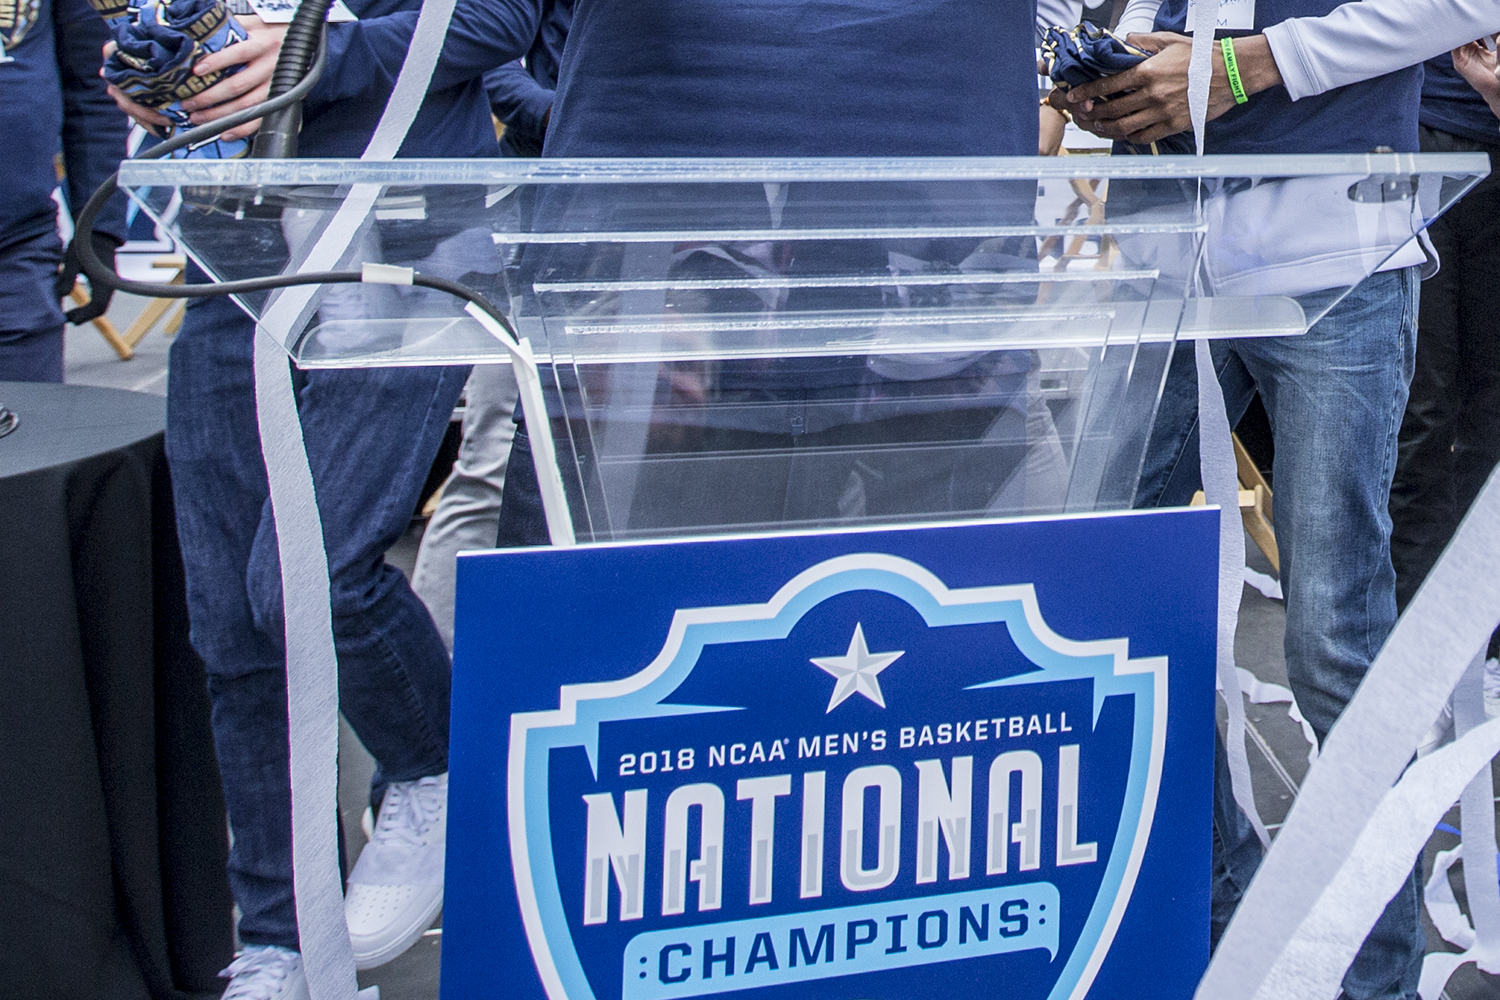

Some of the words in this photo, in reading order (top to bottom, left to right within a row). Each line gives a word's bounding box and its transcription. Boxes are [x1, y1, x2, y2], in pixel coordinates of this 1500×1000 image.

[1225, 47, 1236, 72] FAMILY
[1231, 73, 1242, 97] FIGHT
[618, 746, 696, 777] 2018
[797, 728, 888, 759] MEN'S
[898, 711, 1074, 750] BASKETBALL
[582, 743, 1099, 927] NATIONAL
